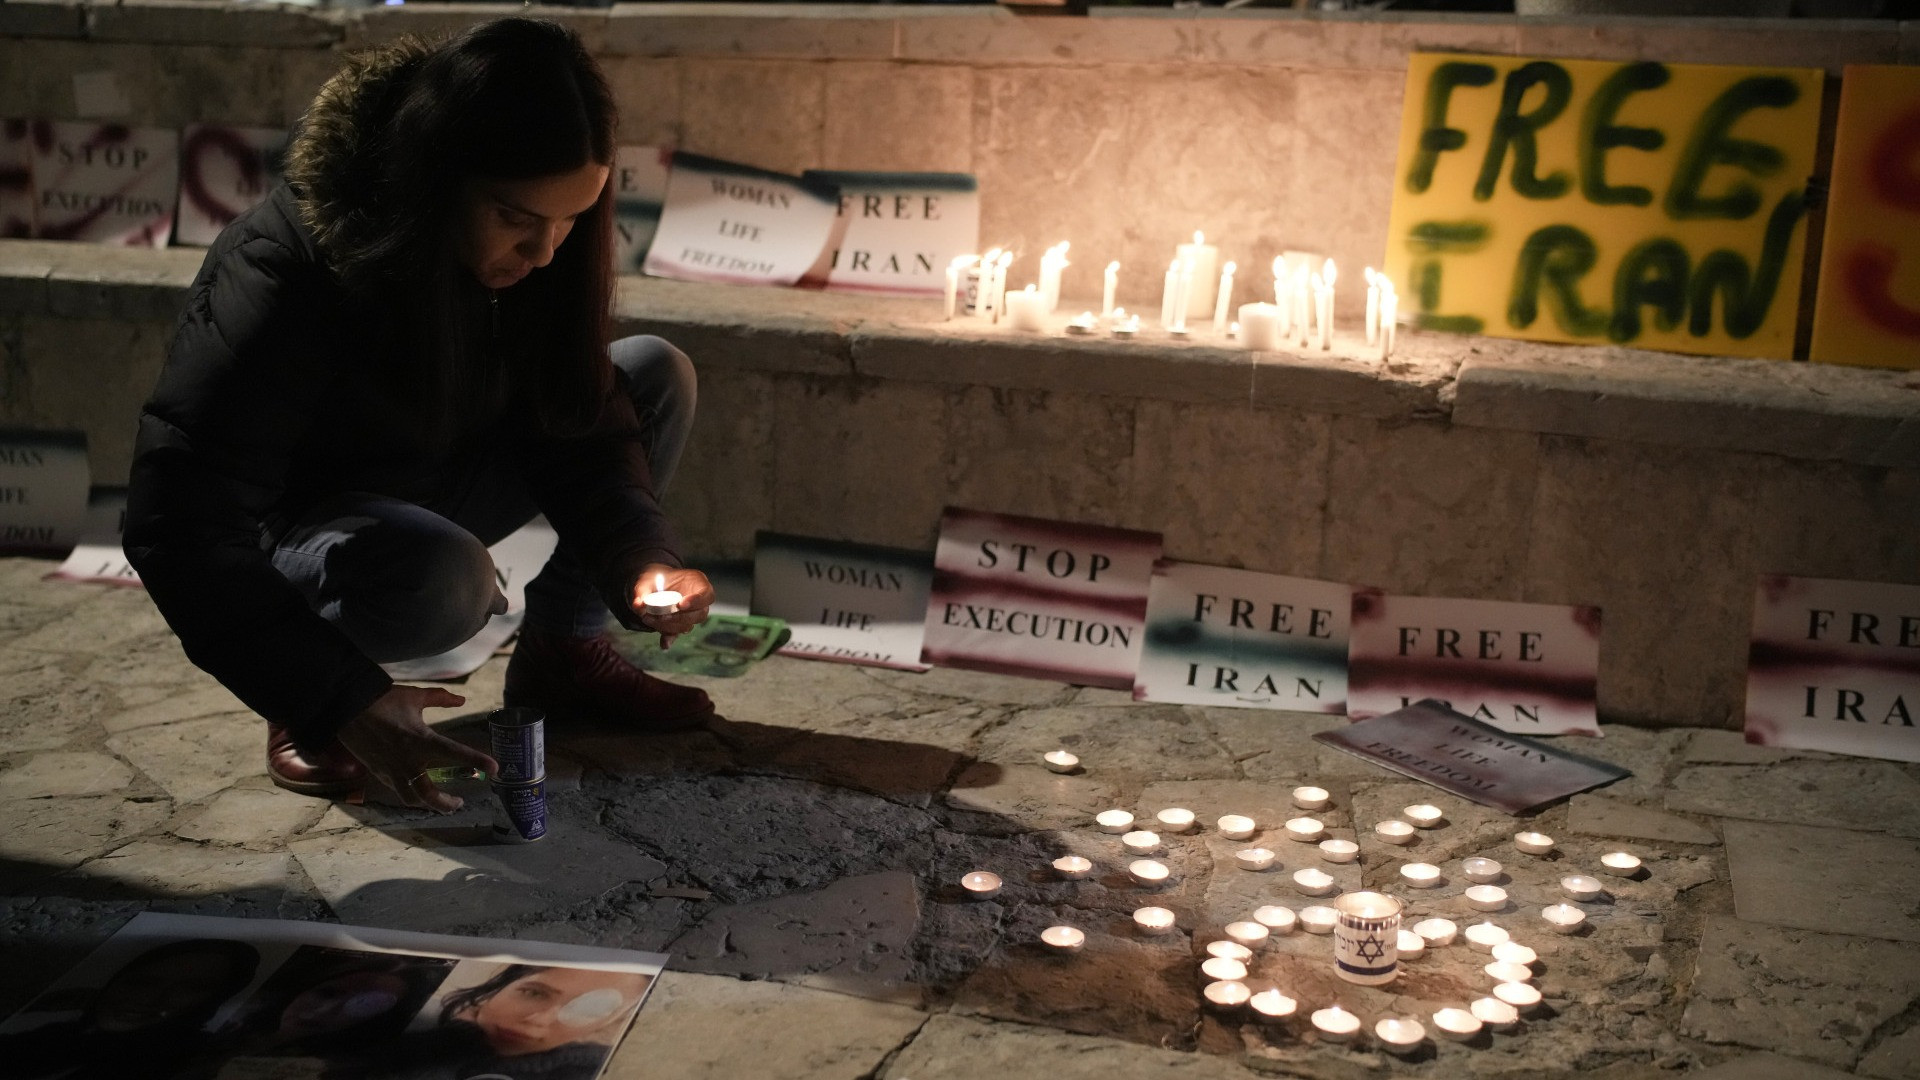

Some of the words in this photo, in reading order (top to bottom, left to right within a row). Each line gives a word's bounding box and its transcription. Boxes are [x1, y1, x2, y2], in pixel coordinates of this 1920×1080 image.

[58, 143, 149, 170] STOP
[1406, 61, 1800, 220] FREE
[711, 179, 791, 210] WOMAN
[836, 194, 942, 221] FREE
[719, 219, 765, 243] LIFE
[680, 248, 776, 275] FREEDOM
[831, 247, 934, 275] IRAN
[1406, 187, 1810, 343] IRAN
[0, 450, 43, 467] MAN
[804, 560, 903, 592] WOMAN
[977, 540, 1111, 582] STOP
[820, 607, 876, 634] LIFE
[942, 602, 1134, 649] EXECUTION
[1193, 593, 1333, 640] FREE
[1806, 609, 1920, 649] FRE
[786, 641, 892, 662] REEDOM
[1398, 627, 1544, 662] FREE
[1185, 663, 1323, 699] IRAN
[1802, 686, 1916, 727] IRA
[1433, 743, 1499, 768] LIFE
[1449, 724, 1553, 764] WOMAN
[1366, 741, 1500, 790] FREEDOM
